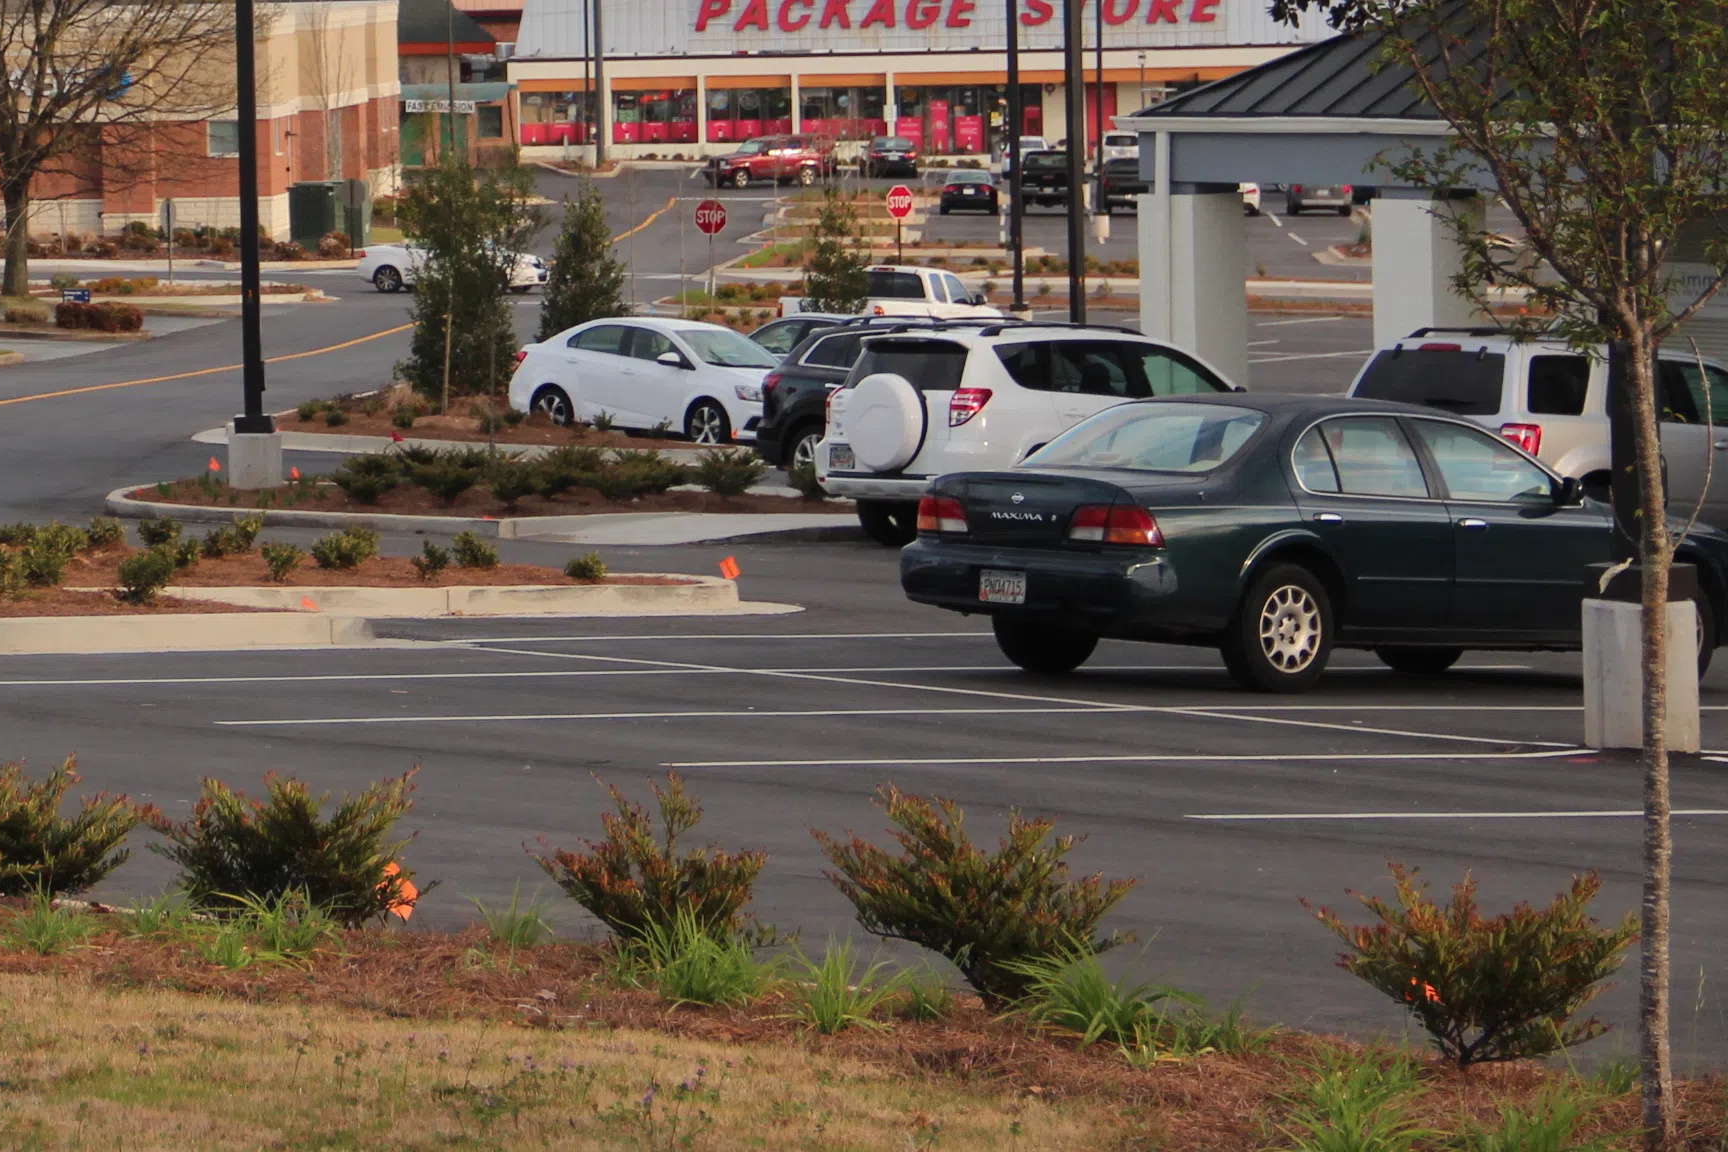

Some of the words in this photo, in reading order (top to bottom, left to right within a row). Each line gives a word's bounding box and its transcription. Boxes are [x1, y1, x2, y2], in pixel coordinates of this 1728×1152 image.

[888, 195, 911, 209] STOP
[696, 210, 726, 224] STOP
[991, 511, 1043, 521] MAXIMA
